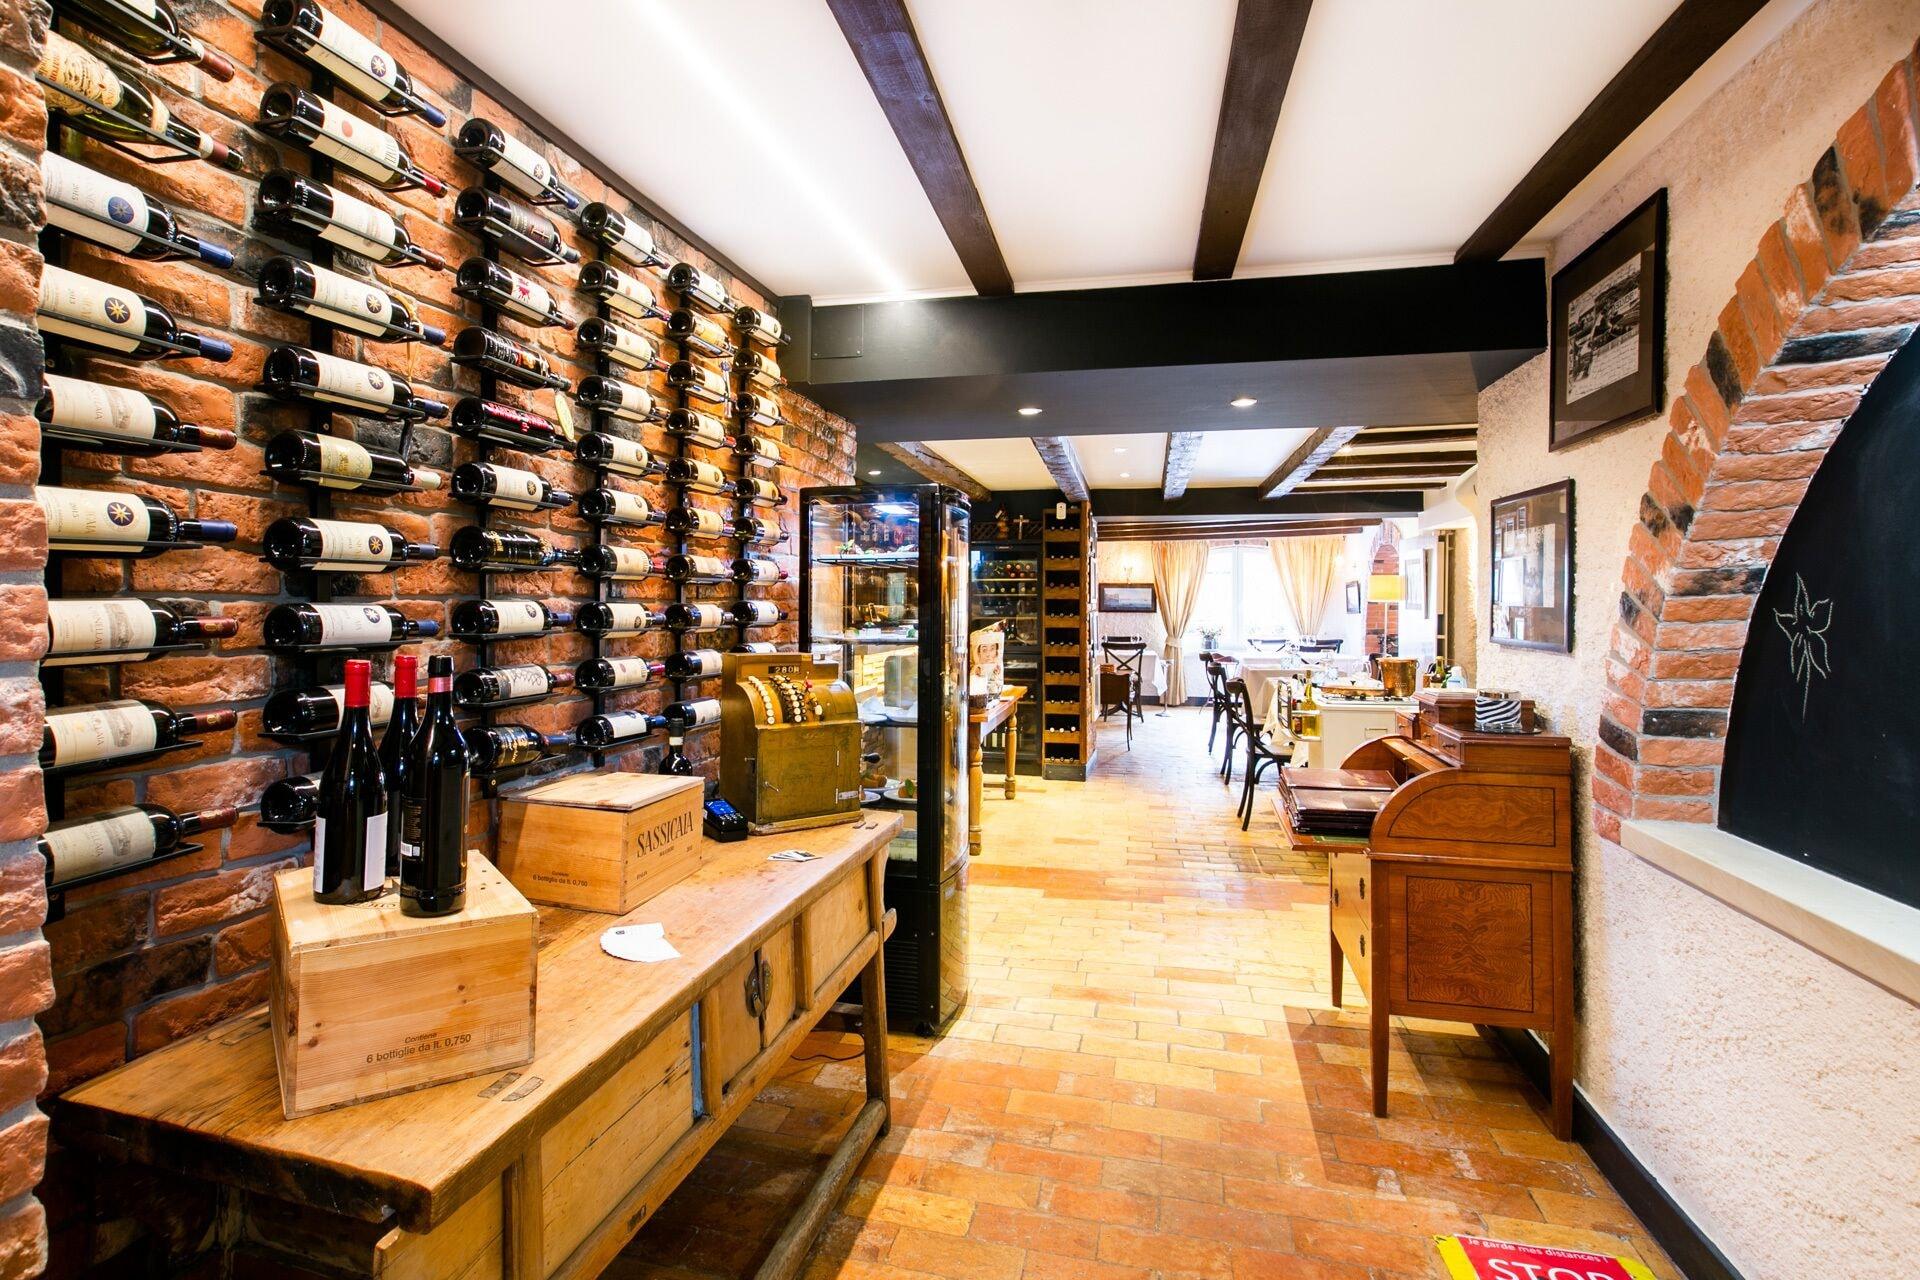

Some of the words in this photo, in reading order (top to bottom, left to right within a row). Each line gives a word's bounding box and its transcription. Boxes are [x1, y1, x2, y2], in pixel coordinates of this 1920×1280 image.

[637, 811, 693, 858] SASSICAIA
[366, 1054, 373, 1063] 6
[376, 1046, 416, 1062] bottiglie
[418, 1042, 431, 1052] da
[444, 1033, 472, 1047] 0,750
[404, 1032, 438, 1044] Contiene
[1468, 1237, 1480, 1246] Je
[1482, 1241, 1516, 1251] garde
[1517, 1245, 1543, 1255] mes
[1545, 1248, 1601, 1262] distances
